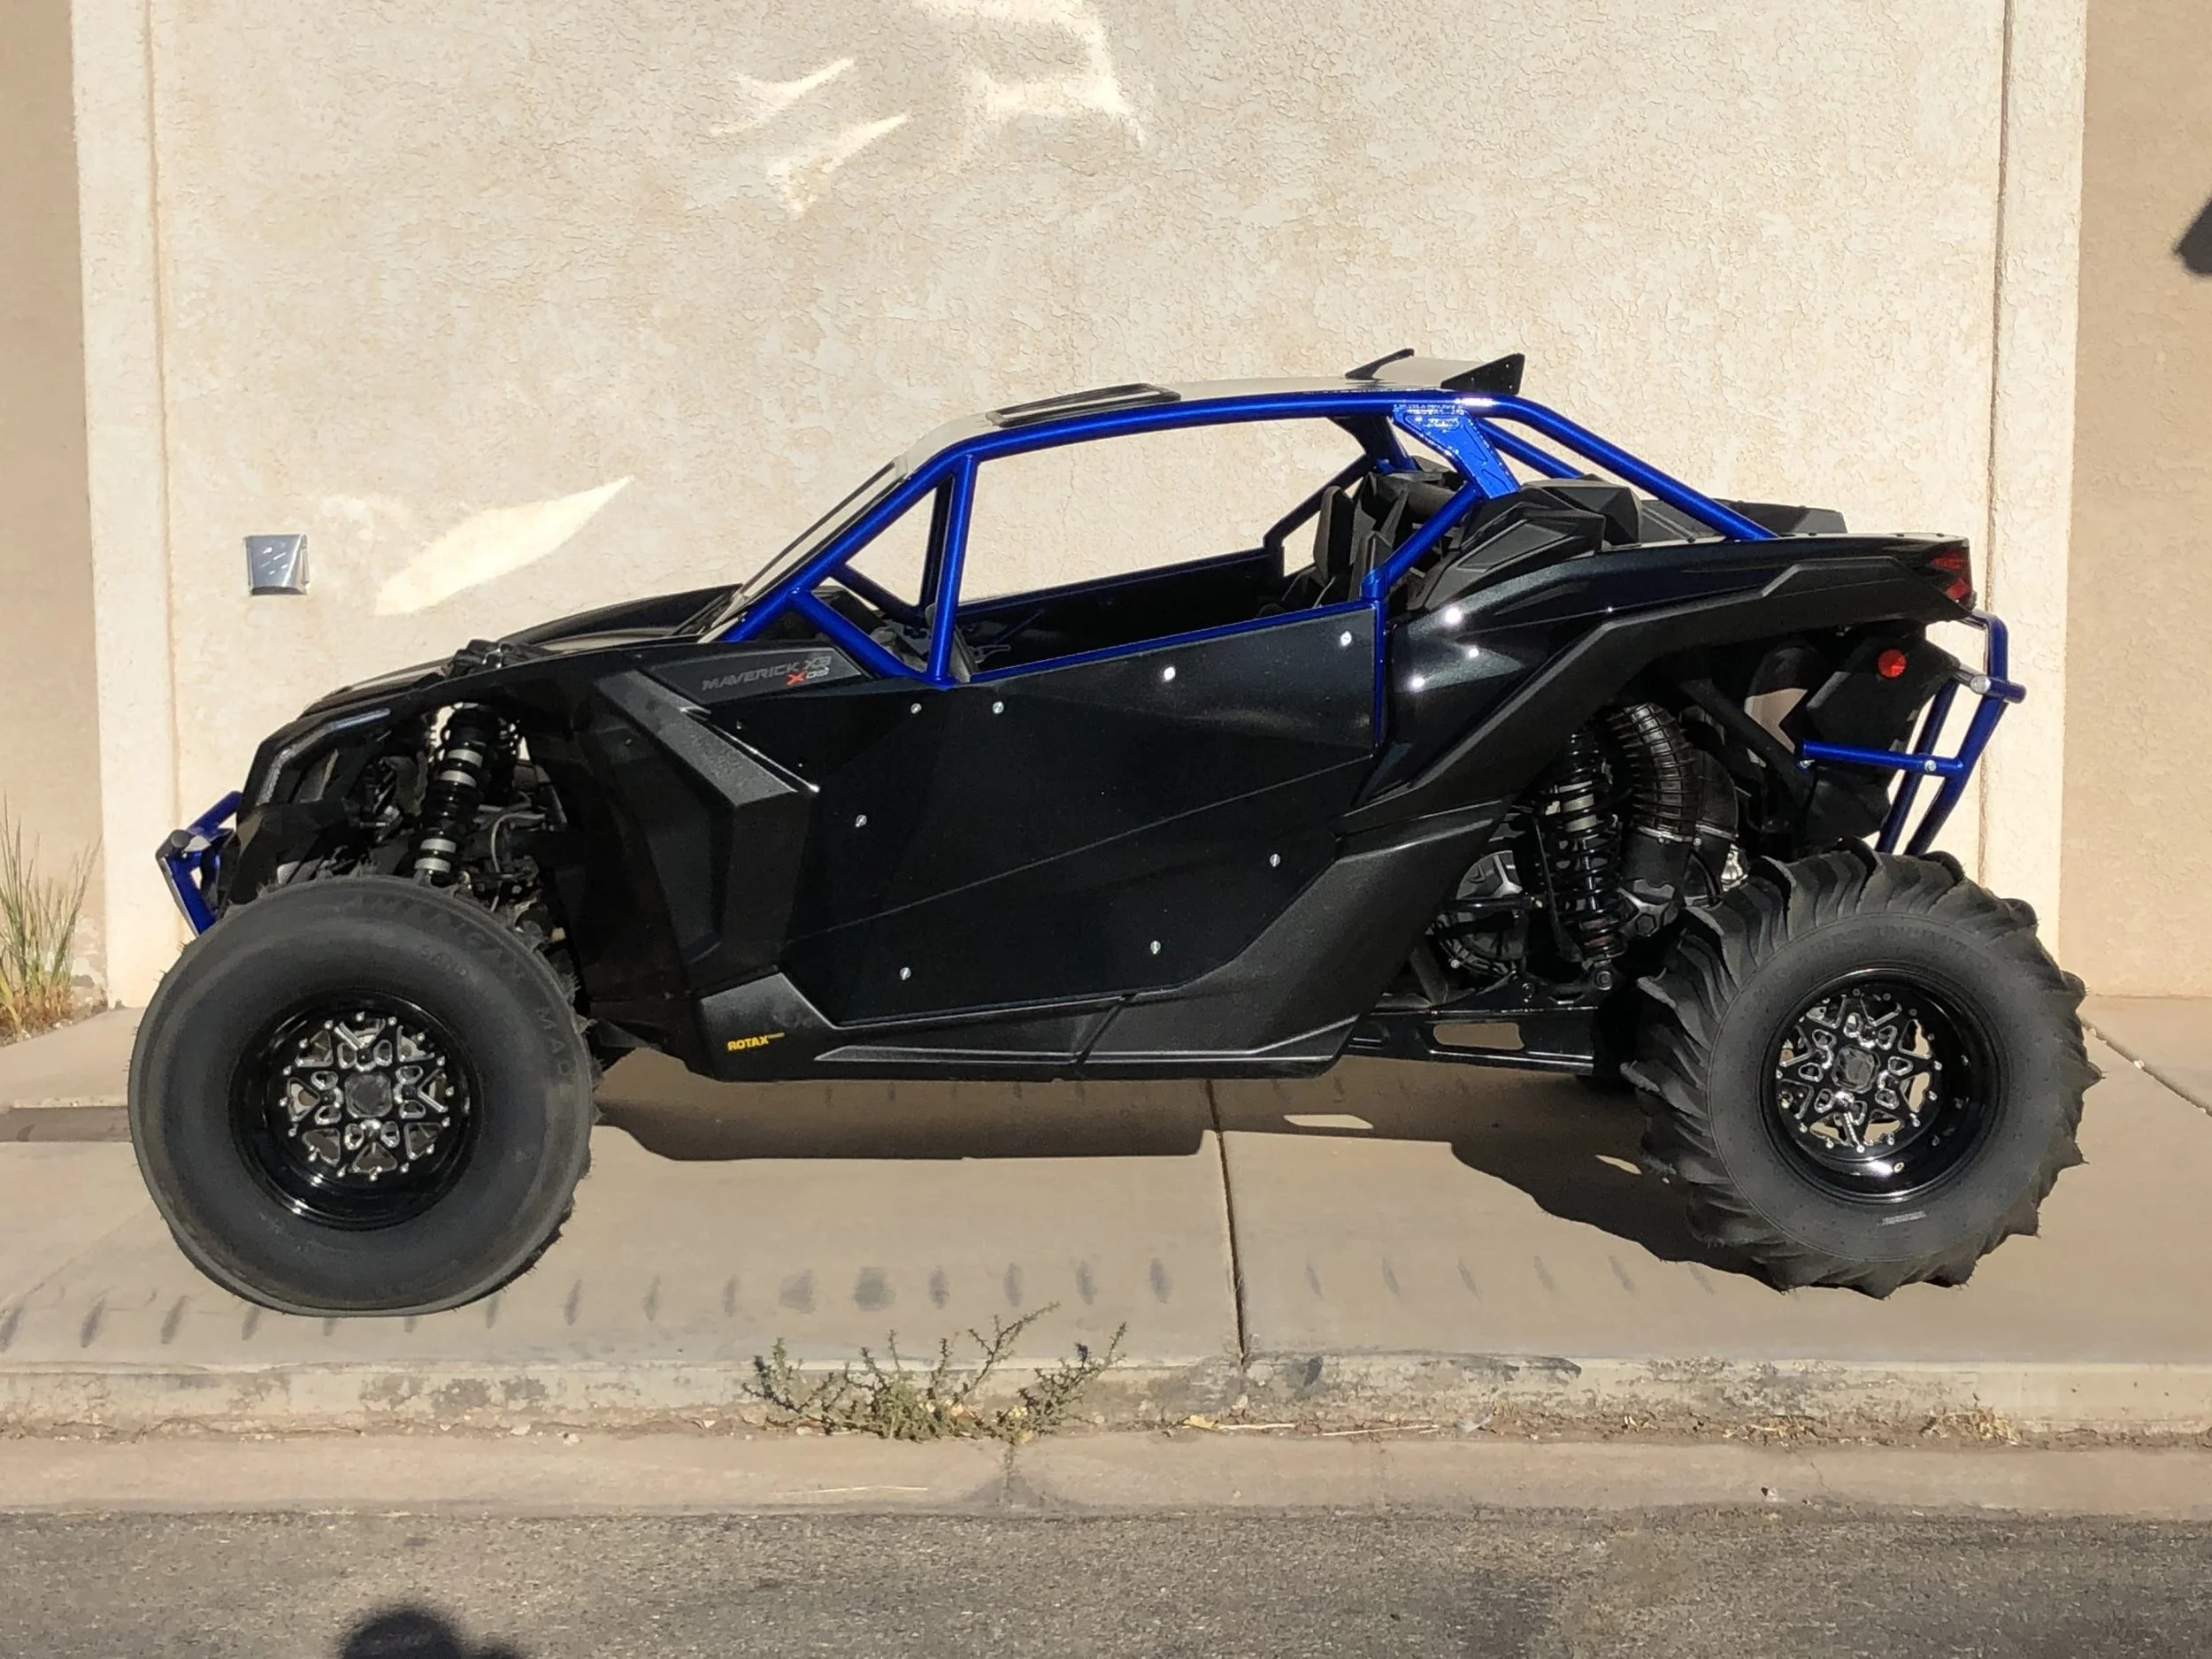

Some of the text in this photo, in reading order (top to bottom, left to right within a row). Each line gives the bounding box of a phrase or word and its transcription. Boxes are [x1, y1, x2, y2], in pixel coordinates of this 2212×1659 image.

[702, 656, 832, 691] MAVERICK X3
[727, 1034, 769, 1052] ROTAX
